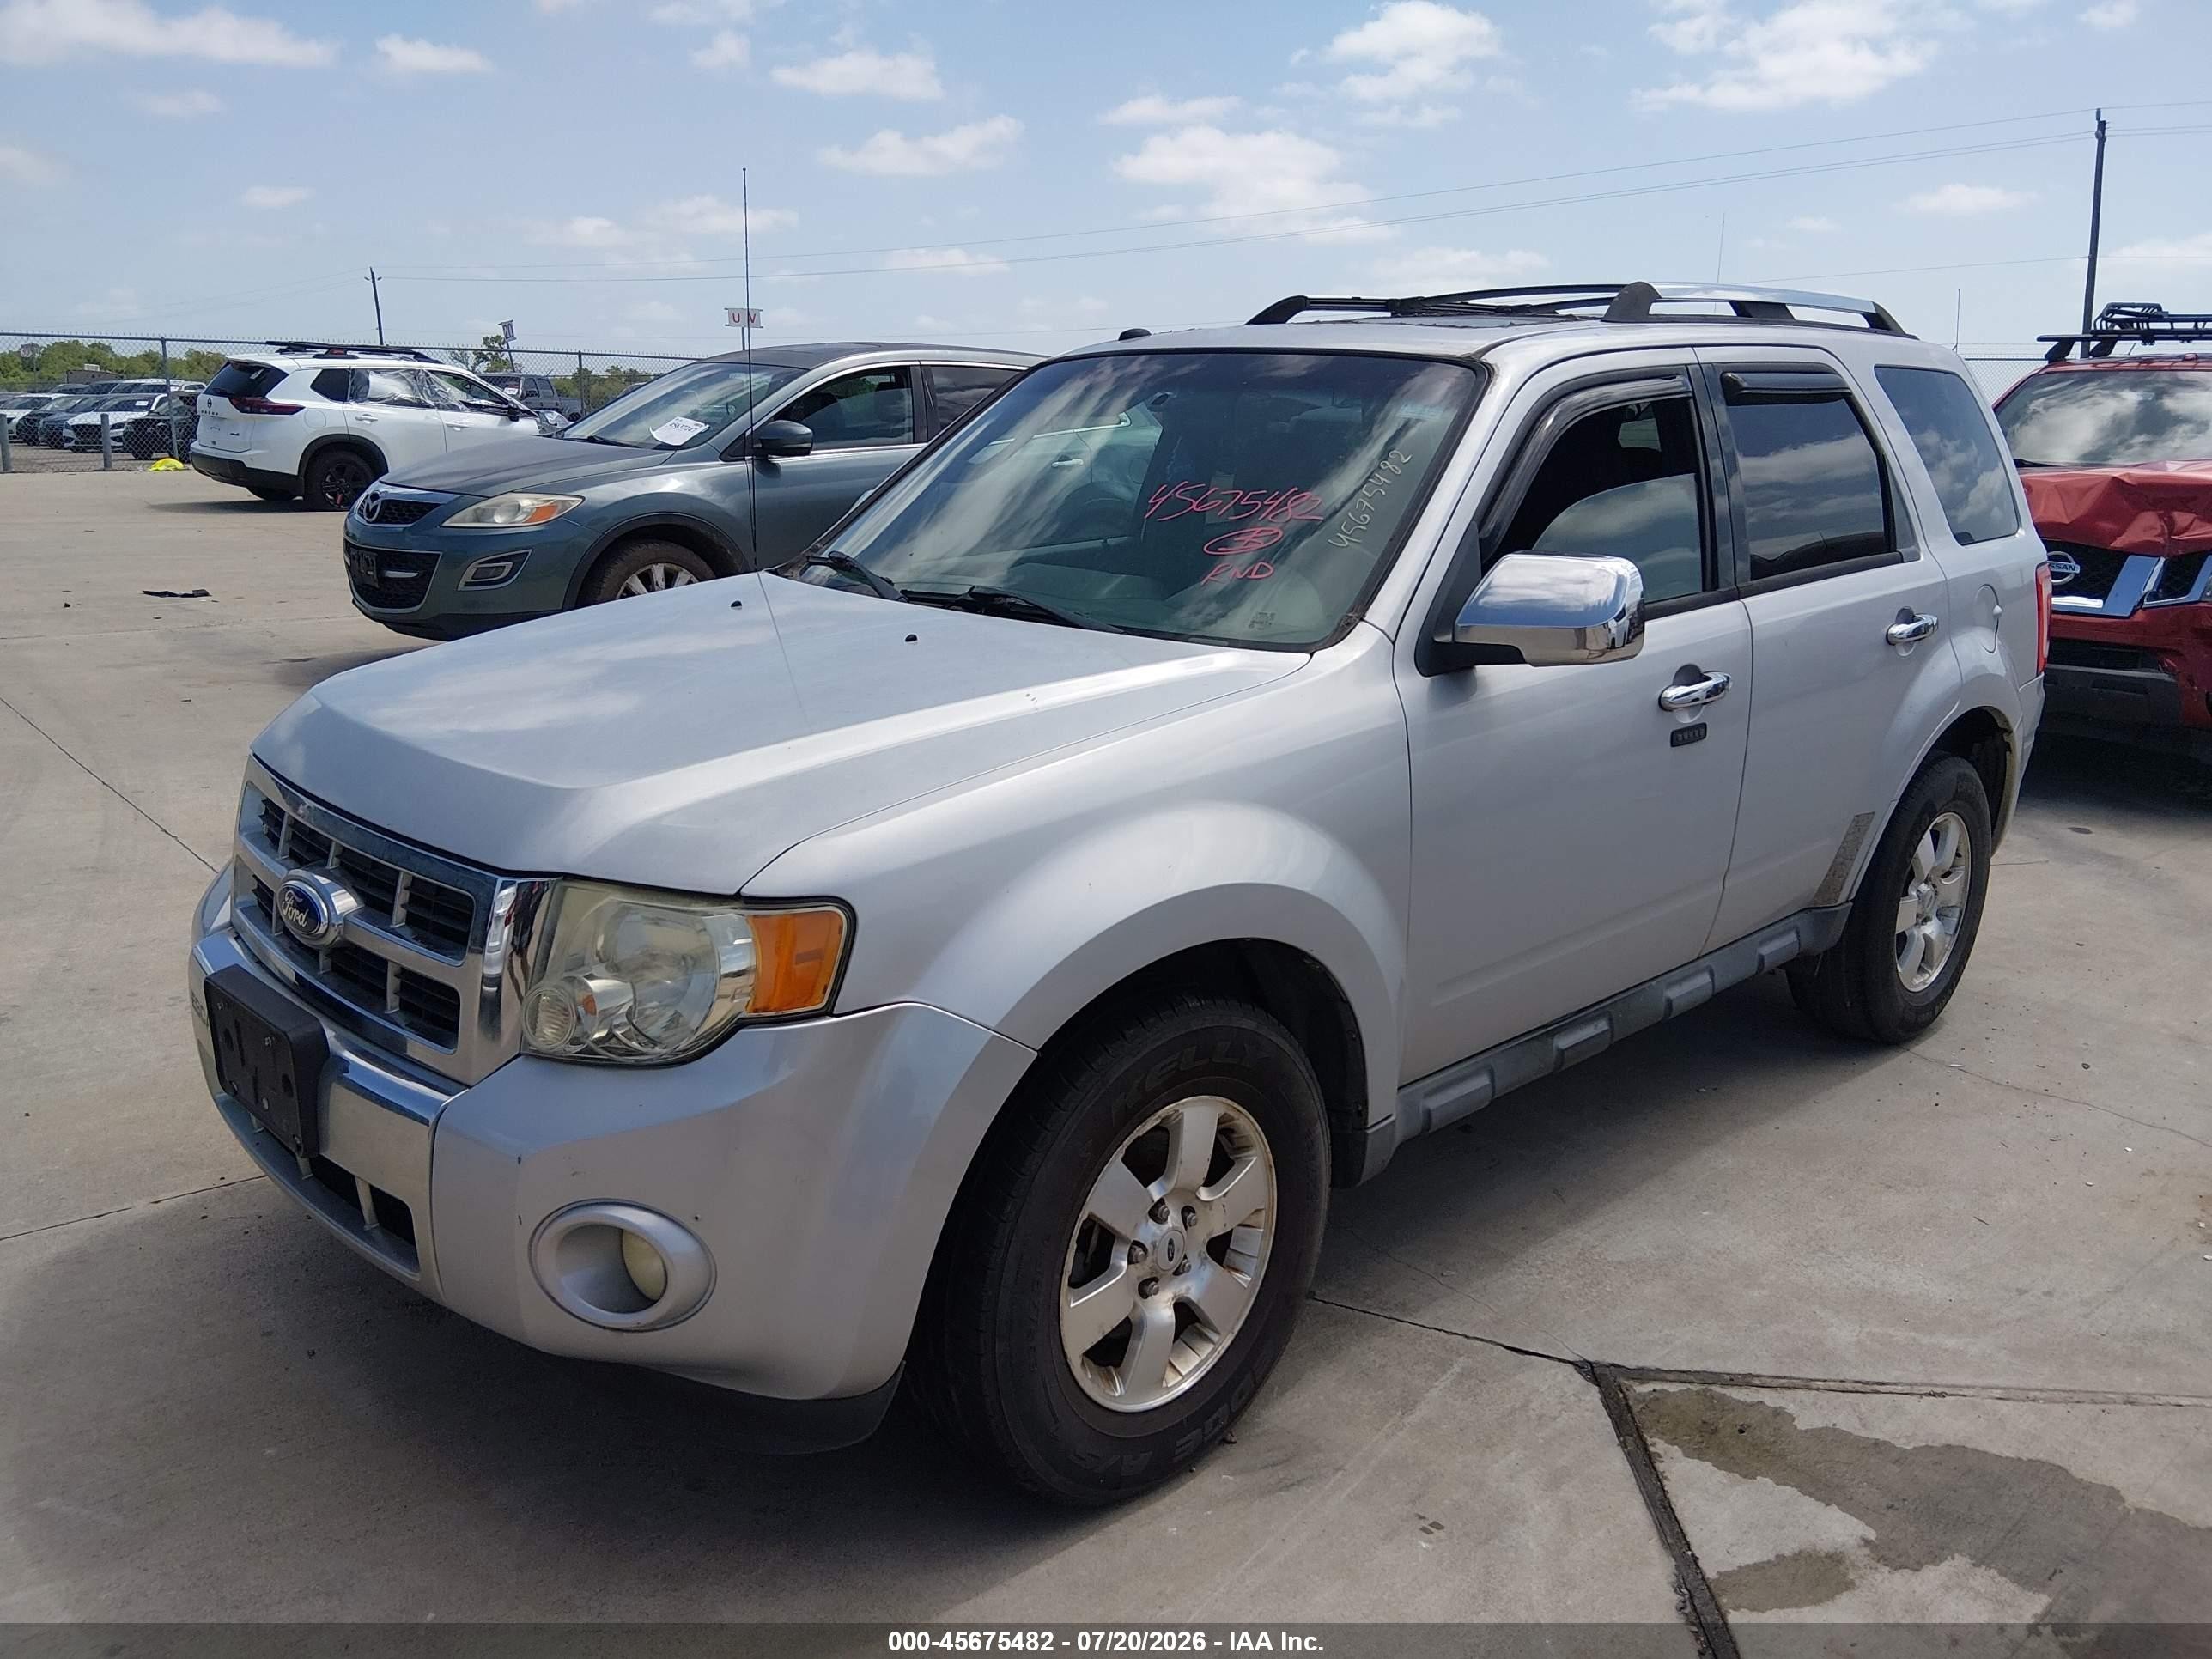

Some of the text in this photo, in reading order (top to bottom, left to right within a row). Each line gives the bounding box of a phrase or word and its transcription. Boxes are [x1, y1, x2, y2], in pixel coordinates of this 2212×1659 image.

[1144, 481, 1324, 523] 45675482
[1327, 450, 1413, 547] 45675482
[282, 890, 309, 927] Ford
